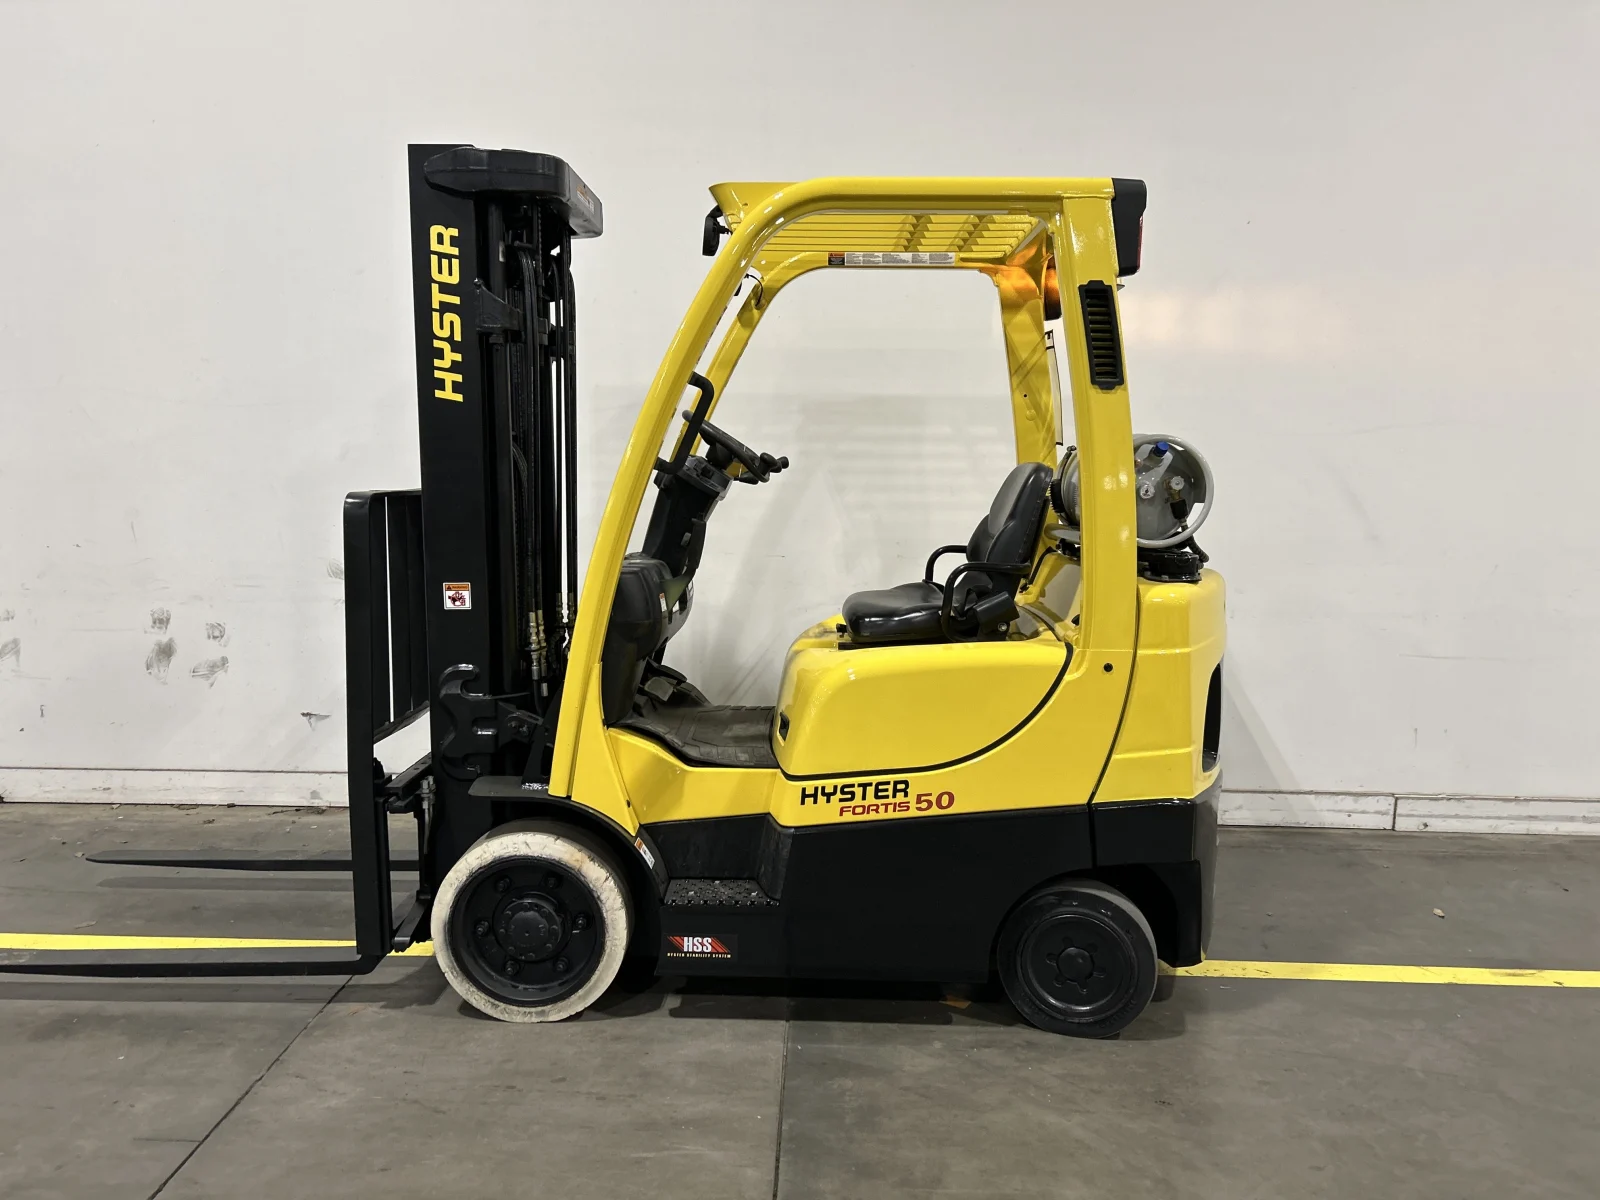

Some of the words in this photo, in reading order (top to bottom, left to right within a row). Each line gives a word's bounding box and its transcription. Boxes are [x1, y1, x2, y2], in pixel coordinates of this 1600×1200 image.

[429, 224, 464, 402] HYSTER
[800, 779, 910, 806] HYSTER
[839, 801, 911, 817] FORTIS
[915, 791, 955, 812] 50
[683, 936, 712, 953] HSS
